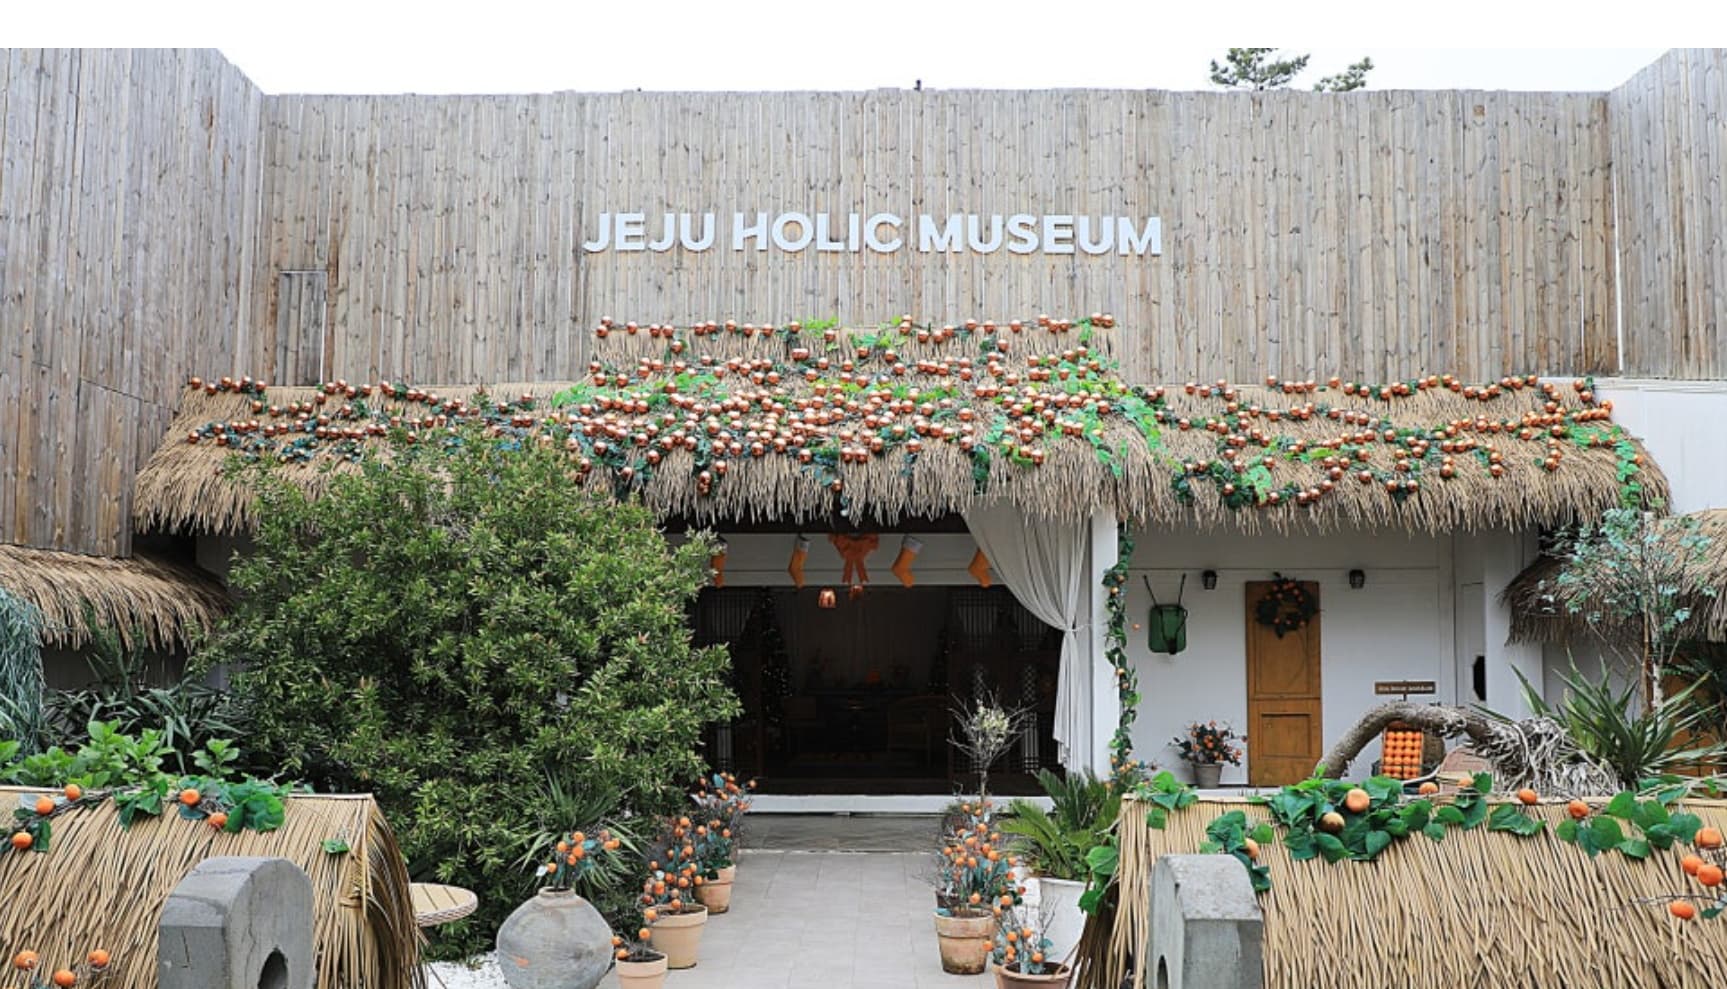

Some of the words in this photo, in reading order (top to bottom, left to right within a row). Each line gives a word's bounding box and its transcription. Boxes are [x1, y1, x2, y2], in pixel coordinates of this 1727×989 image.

[582, 212, 716, 252] JEJU
[732, 211, 903, 253] HOLIC
[918, 213, 1162, 256] MUSEUM
